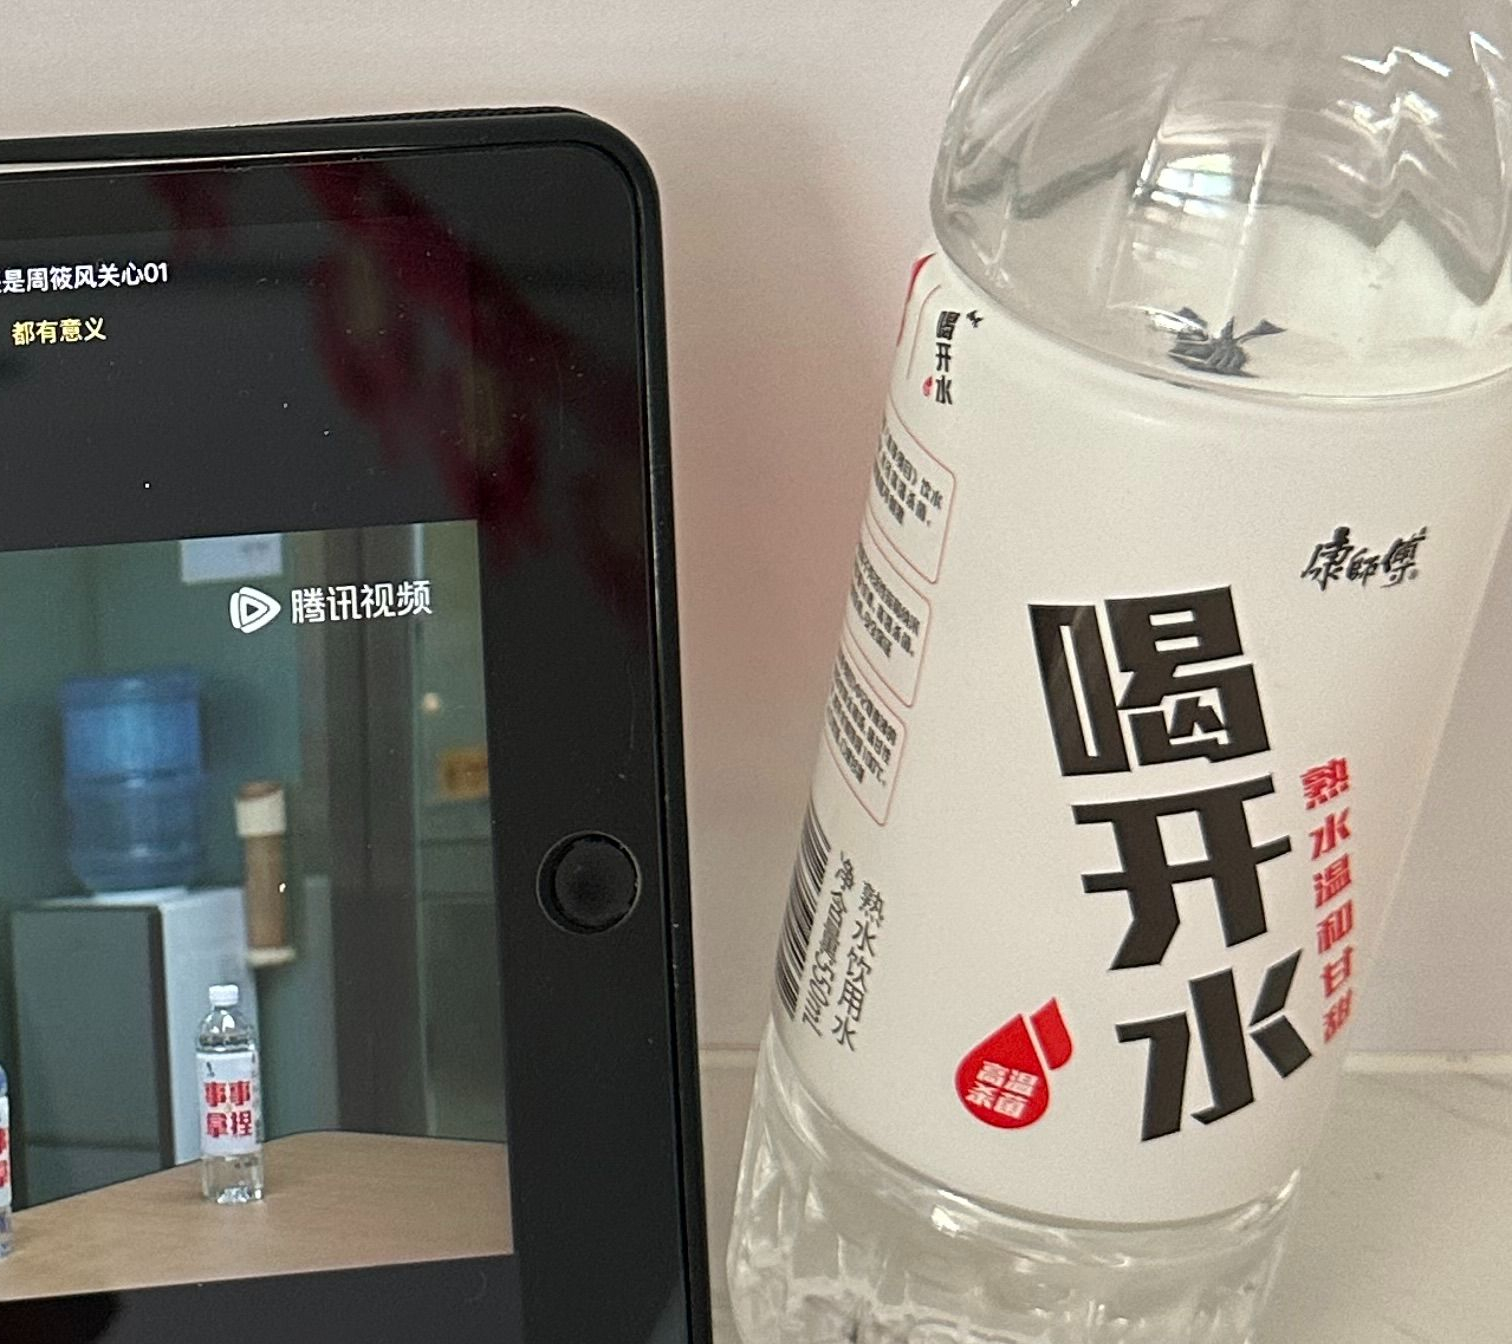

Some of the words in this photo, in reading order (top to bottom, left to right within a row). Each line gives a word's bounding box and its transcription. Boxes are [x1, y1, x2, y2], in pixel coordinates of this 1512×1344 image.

[936, 311, 961, 406] 喝开水
[291, 580, 433, 624] 腾讯视频
[1028, 585, 1313, 1142] 喝开水
